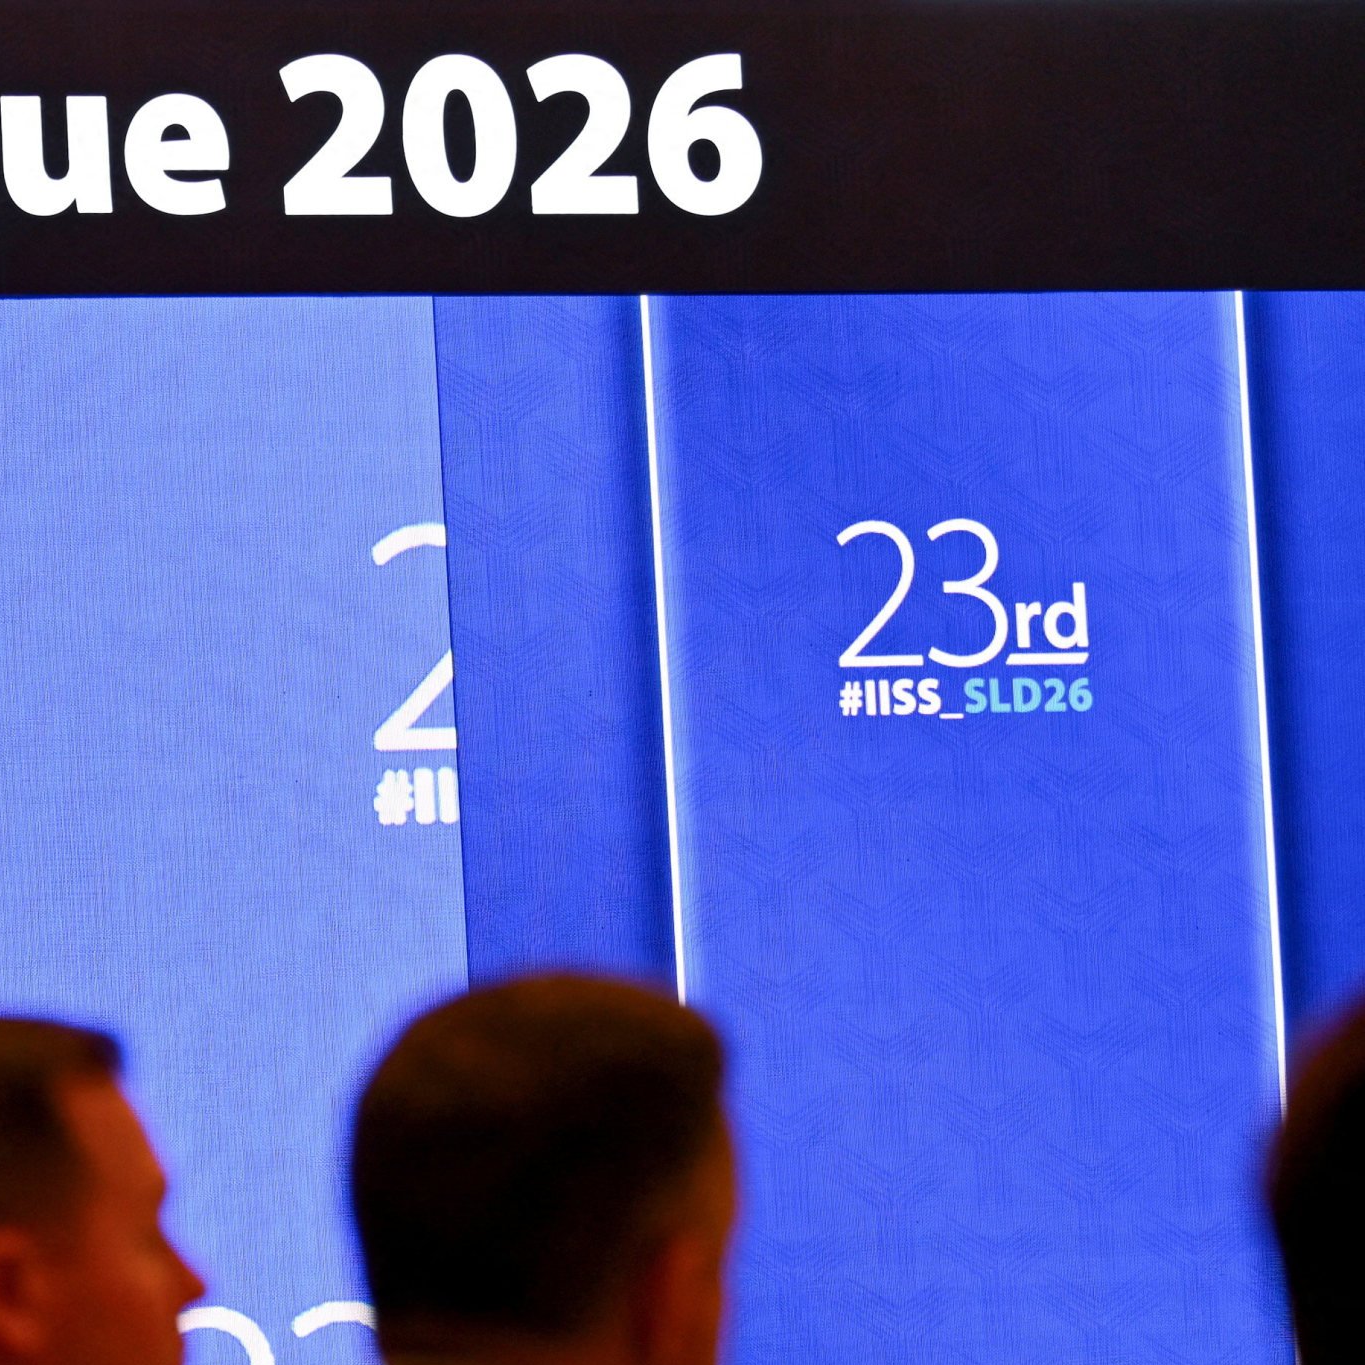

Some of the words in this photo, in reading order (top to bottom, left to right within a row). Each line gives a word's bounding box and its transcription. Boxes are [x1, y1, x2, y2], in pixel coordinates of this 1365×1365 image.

[278, 52, 764, 219] 2026
[835, 517, 1091, 669] 23rd
[837, 676, 1095, 721] #IISS_SLD26
